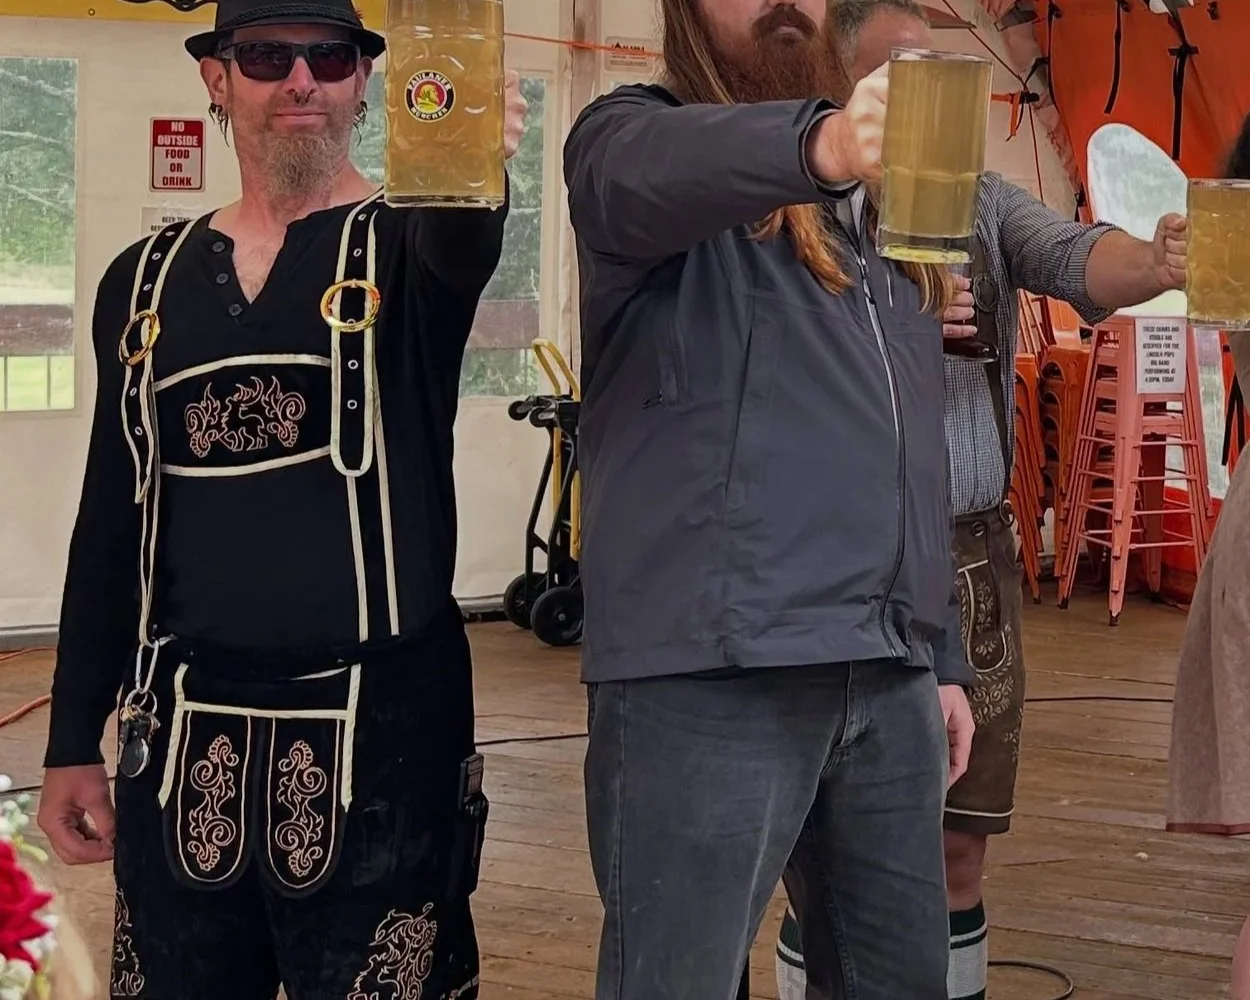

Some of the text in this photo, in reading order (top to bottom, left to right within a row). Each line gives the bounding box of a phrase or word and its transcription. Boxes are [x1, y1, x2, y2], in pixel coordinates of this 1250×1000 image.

[171, 121, 185, 132] NO
[157, 135, 199, 146] OUTSIDE
[165, 149, 190, 159] FOOD
[169, 163, 183, 173] OR
[162, 176, 192, 186] DRINK
